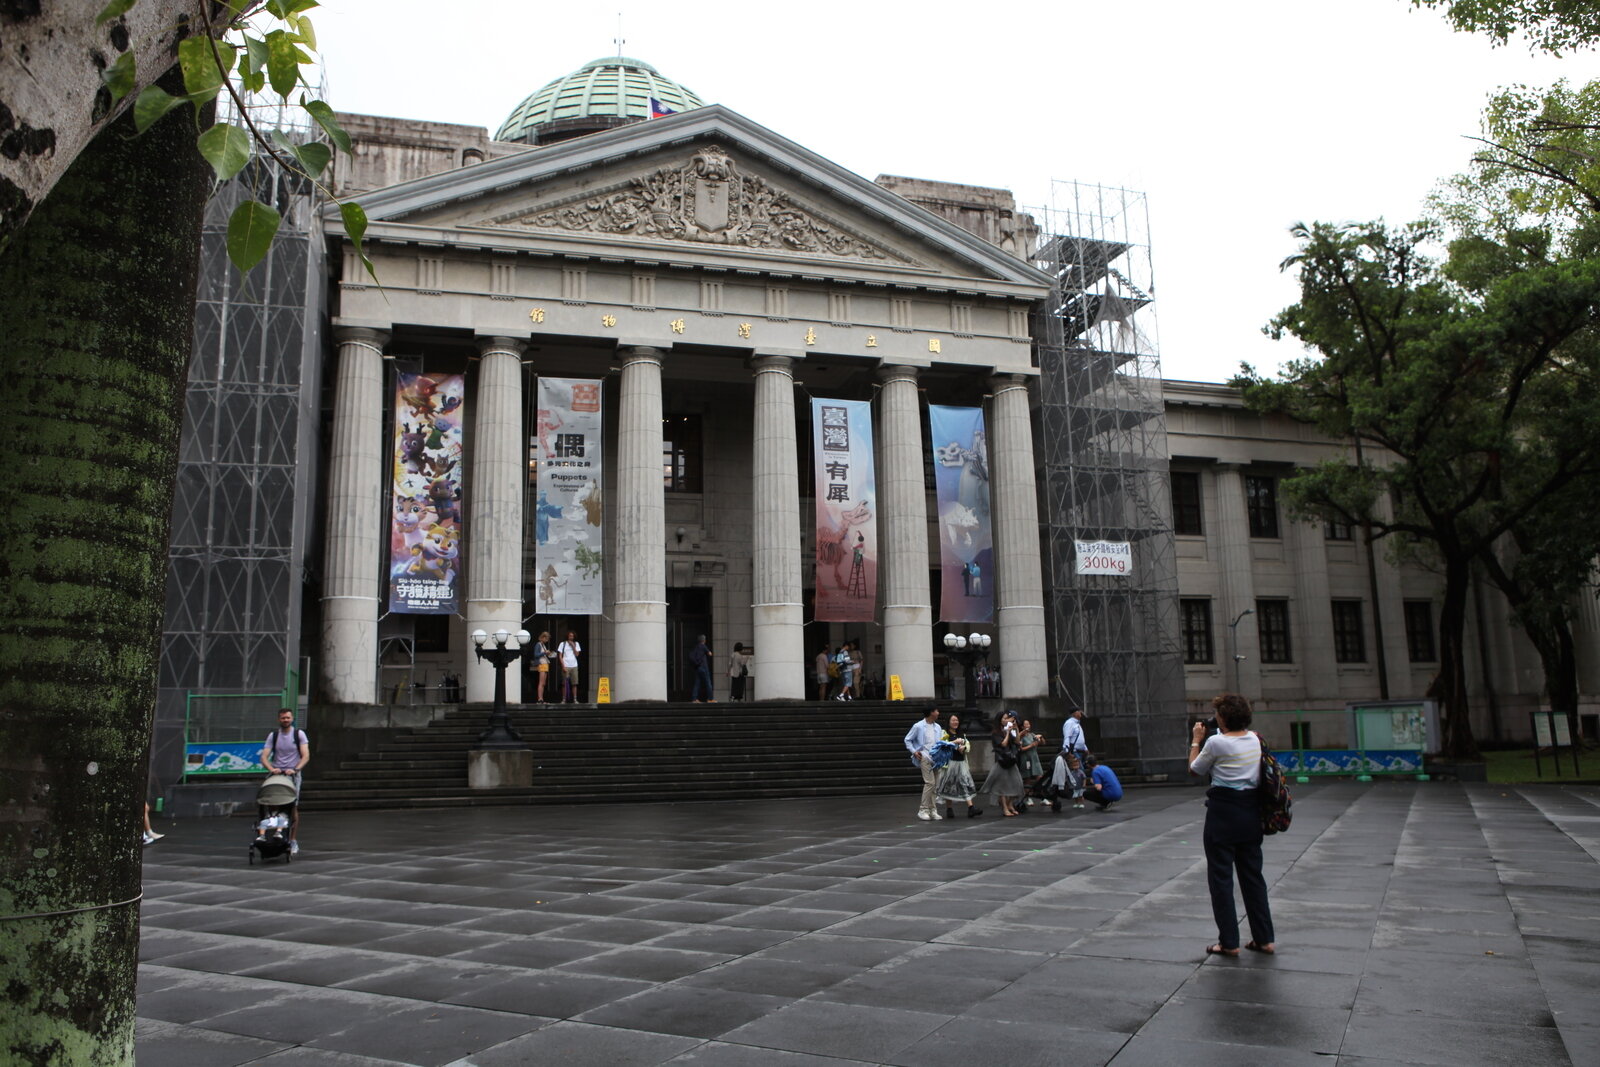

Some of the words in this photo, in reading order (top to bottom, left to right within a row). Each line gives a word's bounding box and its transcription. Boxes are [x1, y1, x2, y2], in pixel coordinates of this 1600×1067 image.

[554, 433, 585, 458] 偶
[551, 473, 588, 482] Puppets
[825, 460, 850, 503] 有犀
[1084, 556, 1125, 572] 300kg
